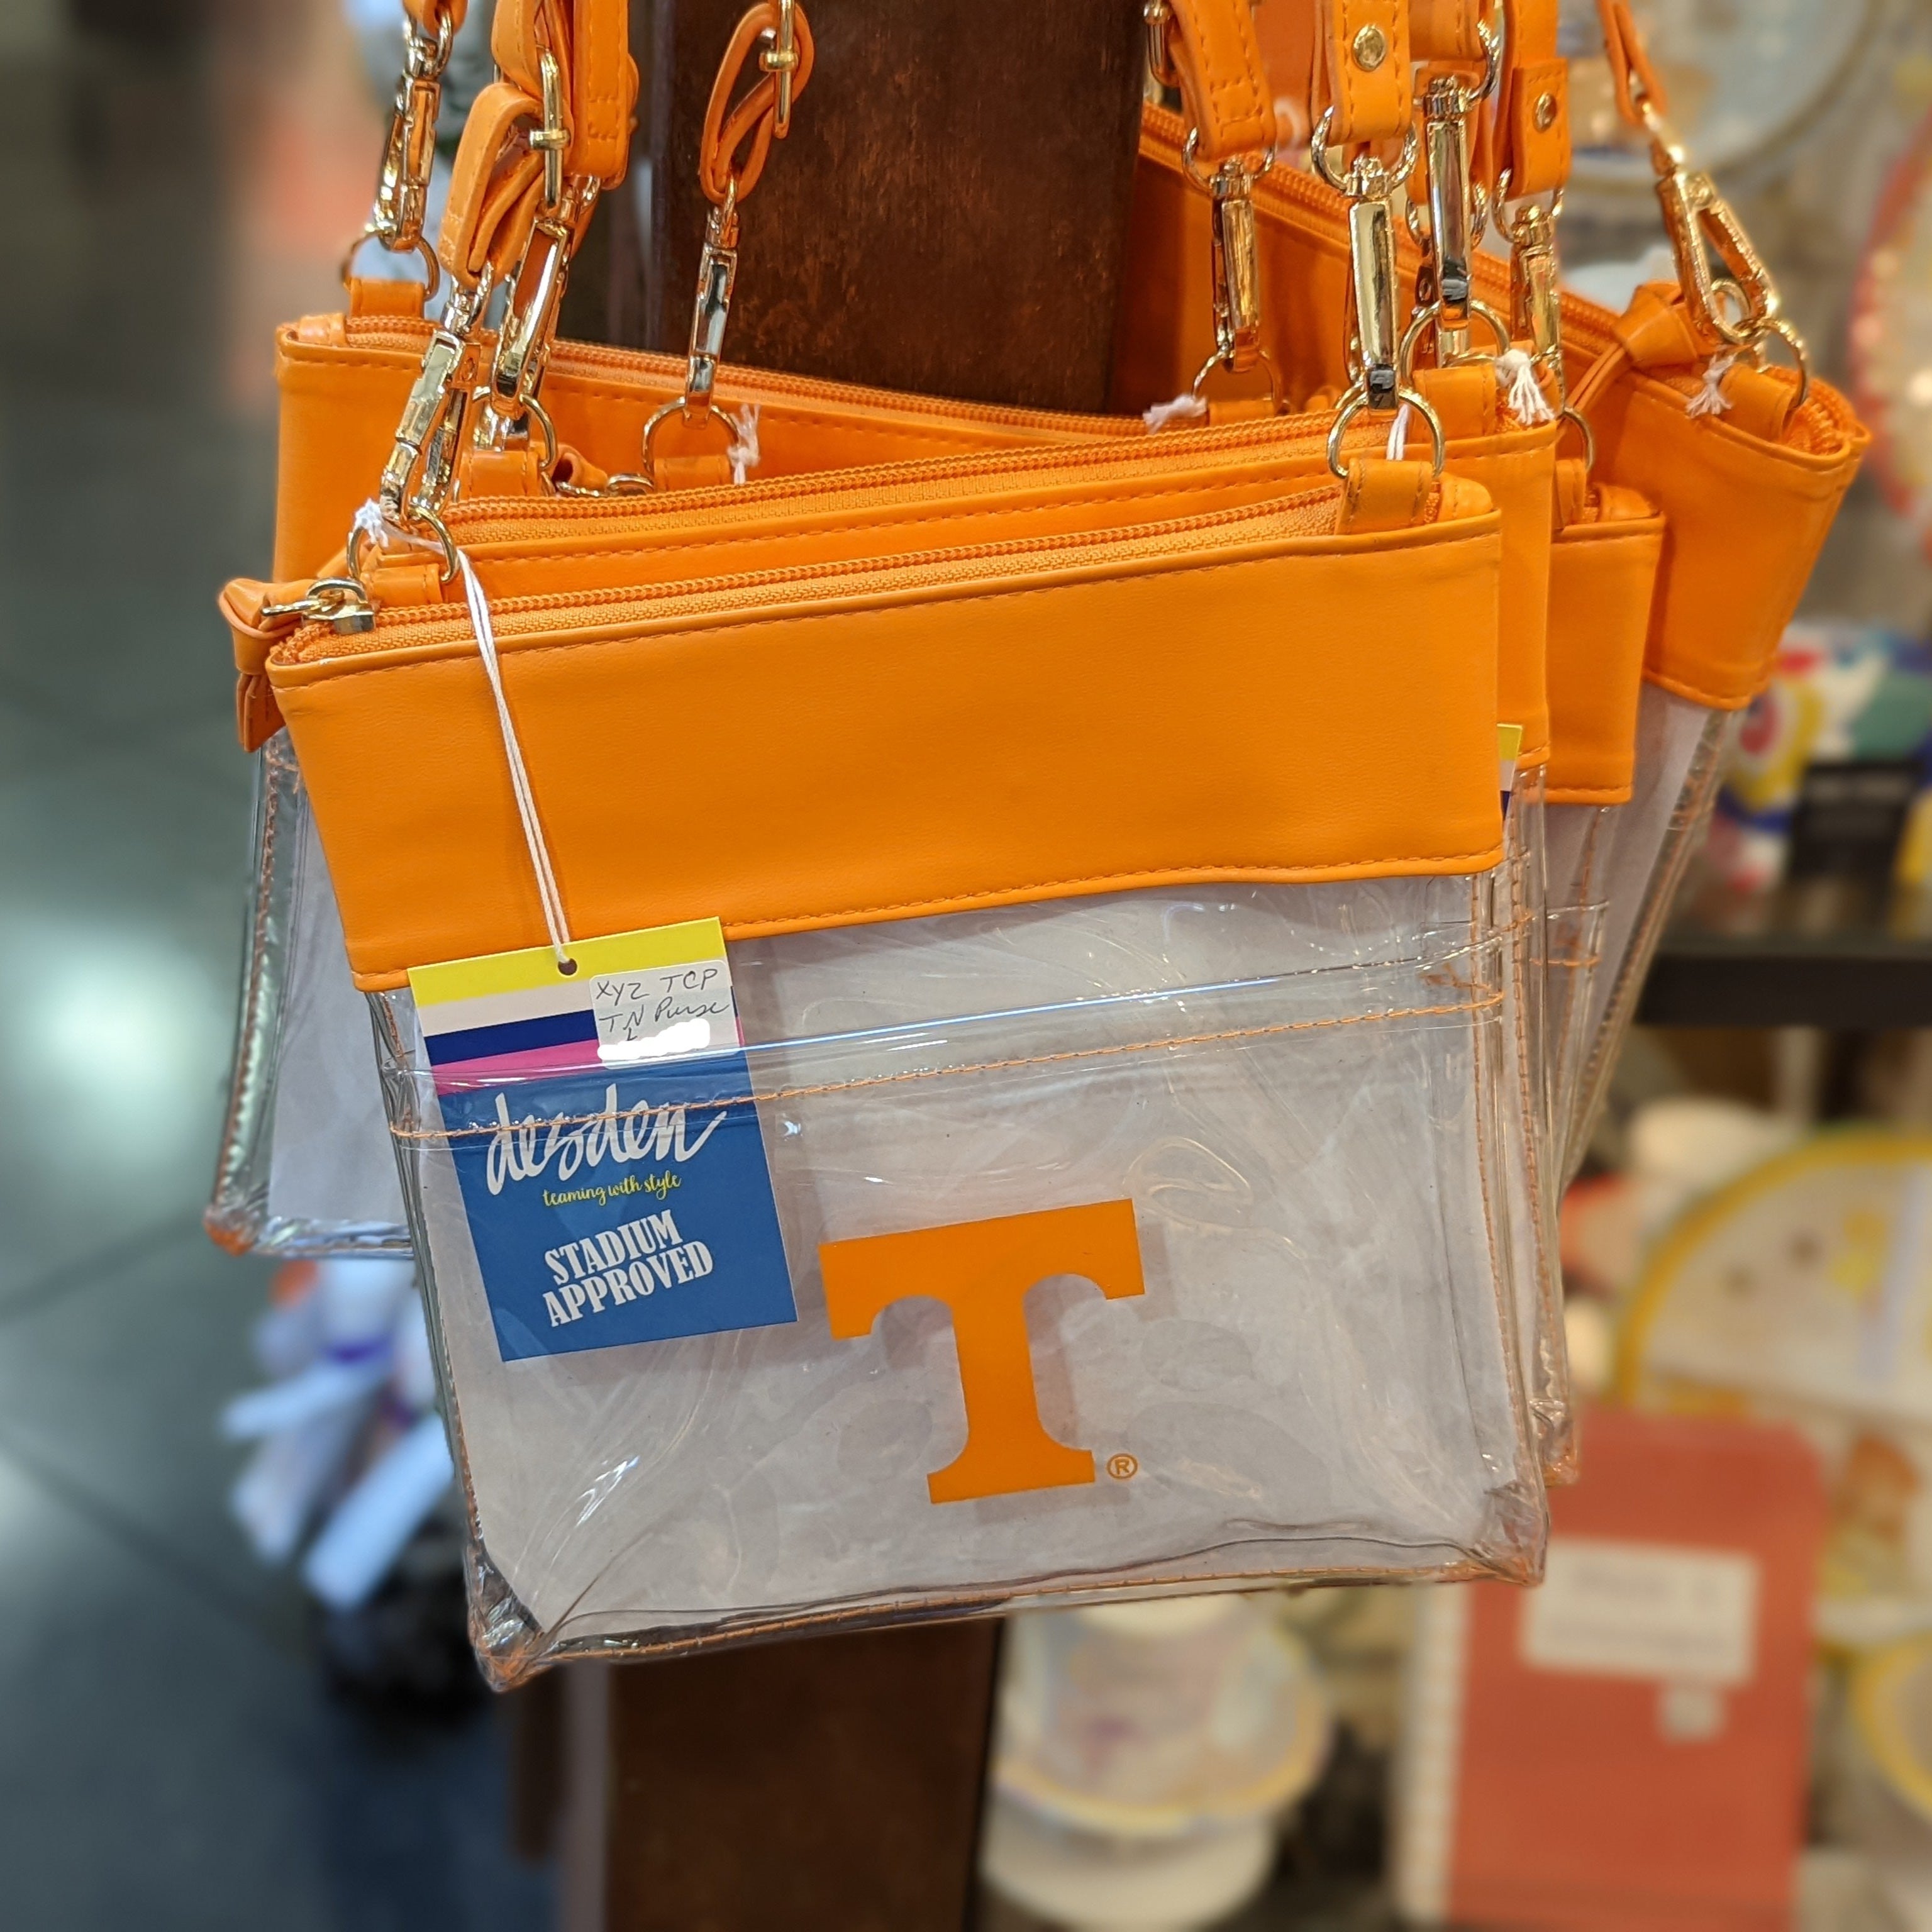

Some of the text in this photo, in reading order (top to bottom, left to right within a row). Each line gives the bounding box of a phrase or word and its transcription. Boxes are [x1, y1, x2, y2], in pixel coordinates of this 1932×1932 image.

[660, 969, 718, 993] TCP
[599, 996, 730, 1033] TN Purse
[542, 1170, 682, 1207] teaming with style
[545, 1209, 682, 1286] STADIUM
[542, 1240, 714, 1328] APPROVED
[819, 1198, 1146, 1505] T
